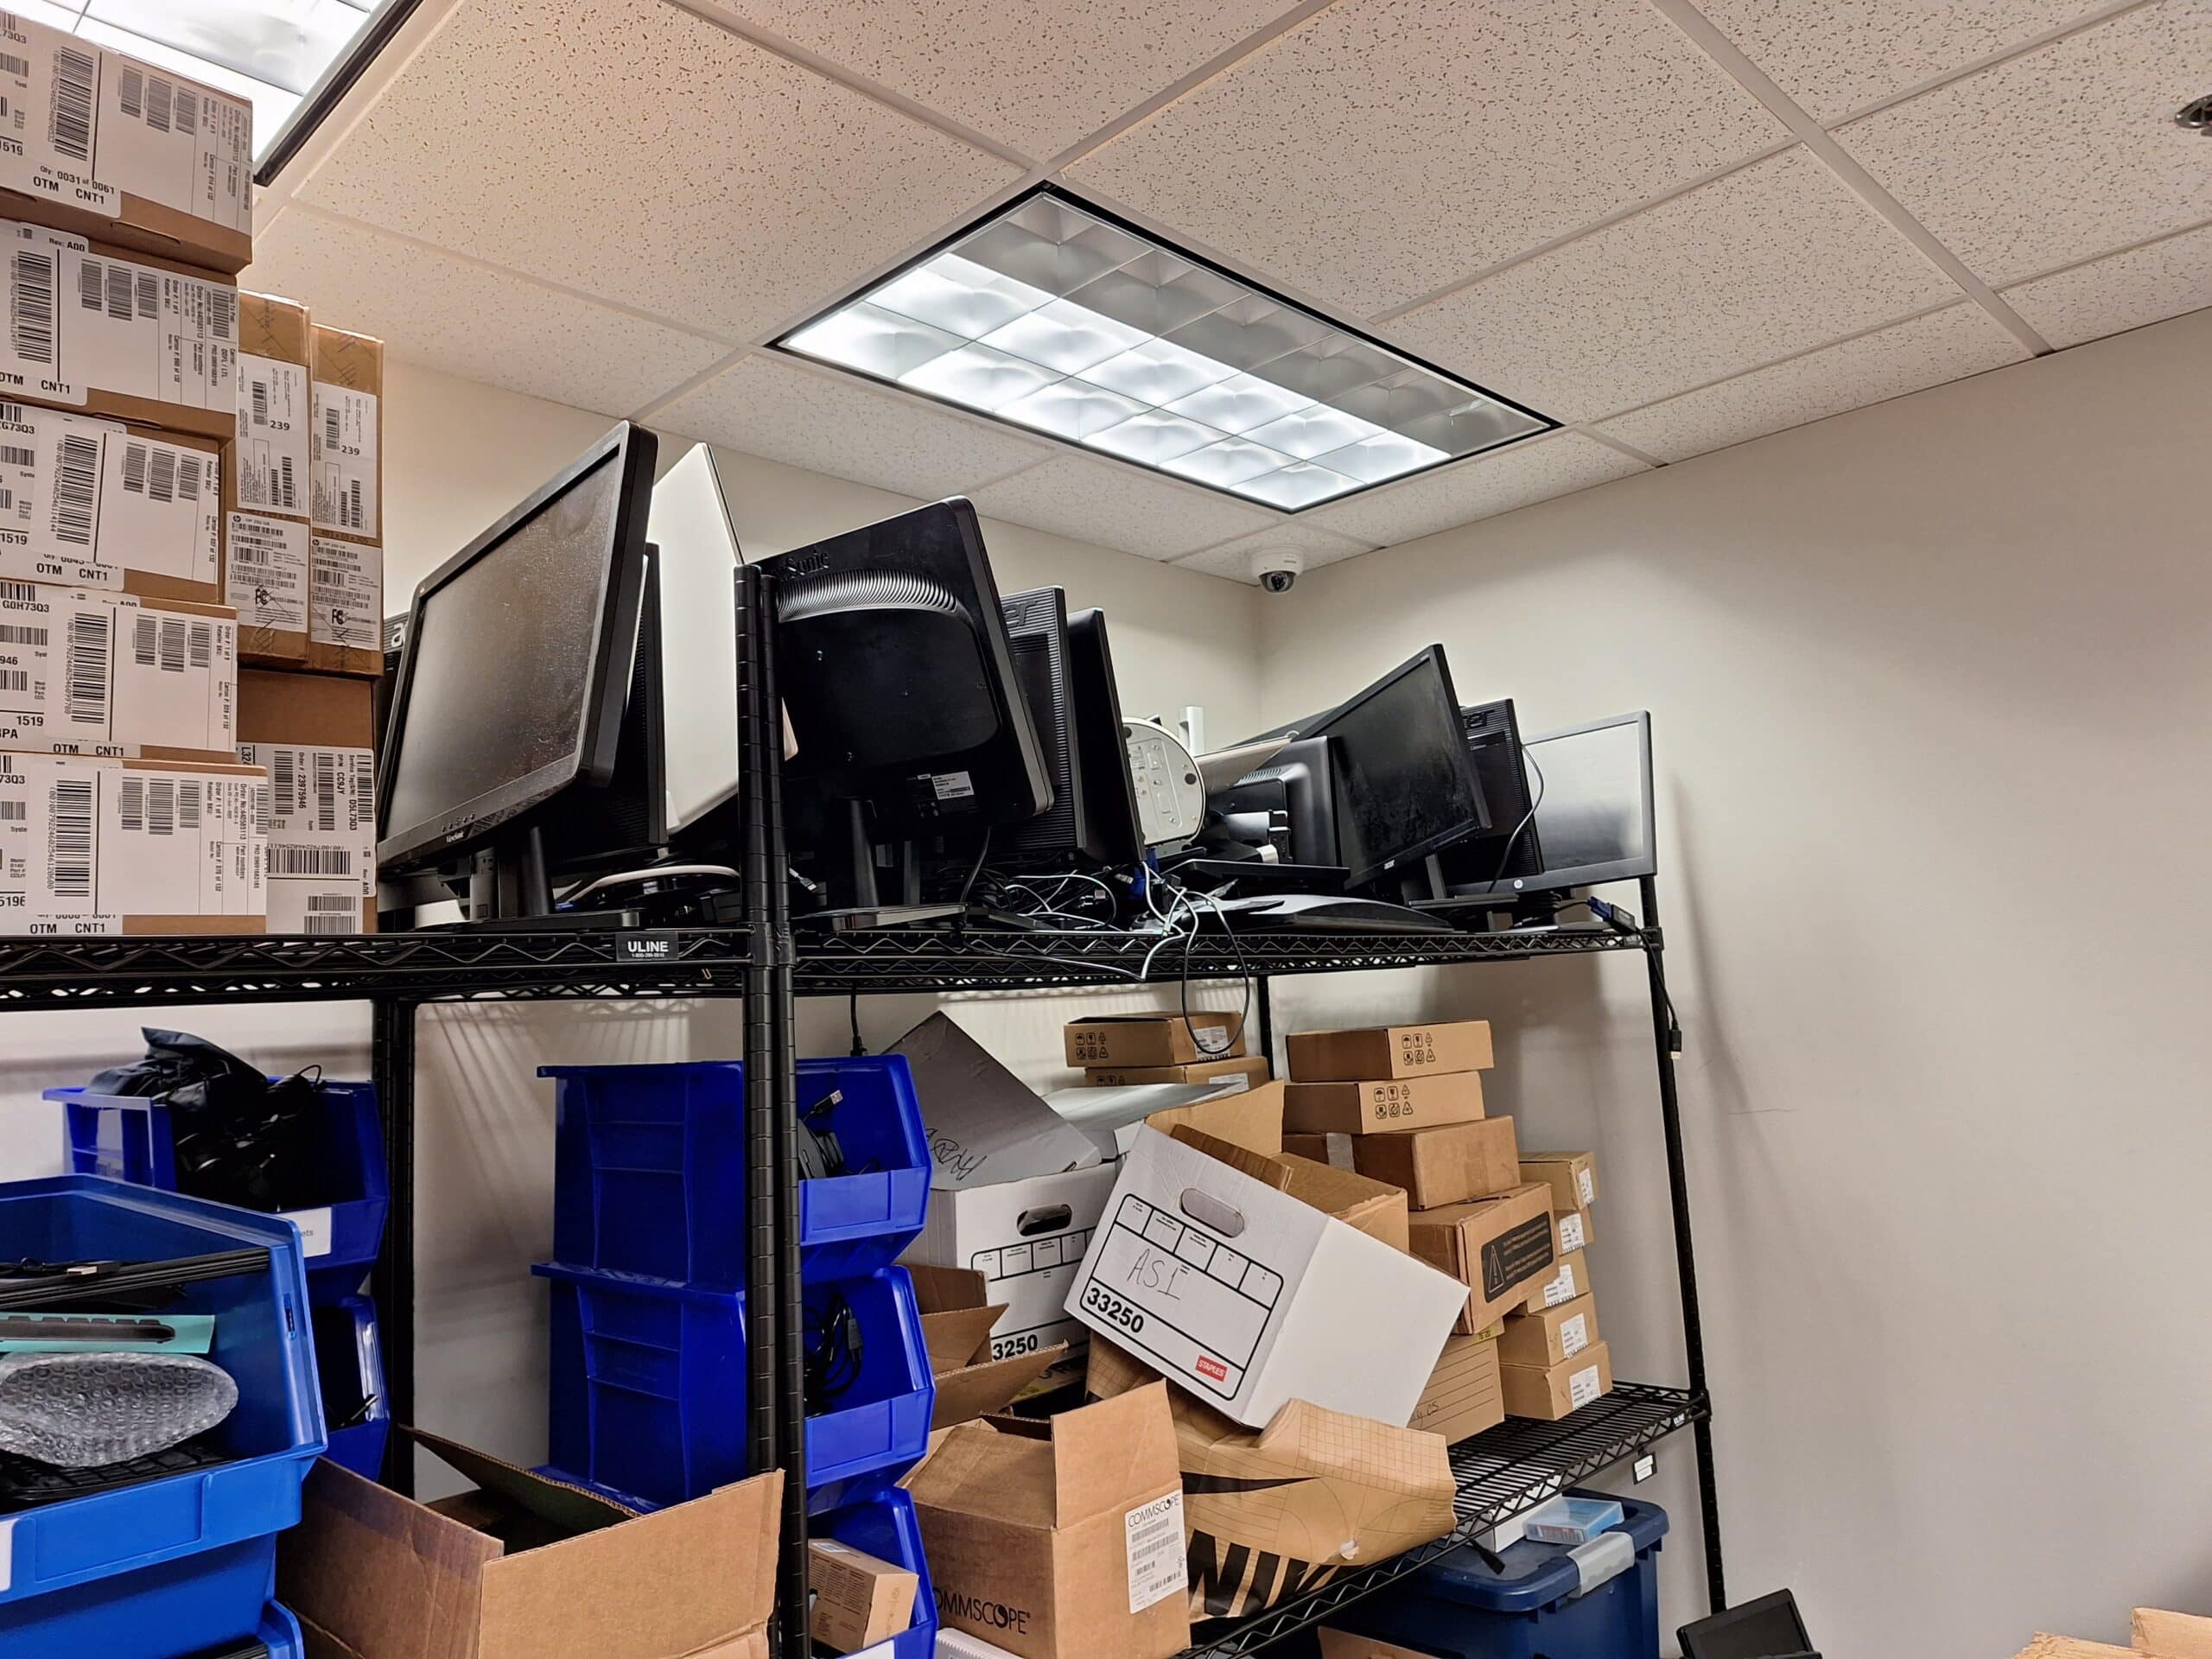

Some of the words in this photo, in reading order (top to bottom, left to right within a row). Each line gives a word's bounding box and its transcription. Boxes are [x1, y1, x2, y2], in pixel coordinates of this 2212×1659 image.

[0, 28, 27, 45] 73Q3
[57, 171, 80, 185] 0031
[33, 176, 60, 192] OTM
[75, 188, 105, 205] CNT1
[67, 241, 86, 253] A00
[0, 371, 24, 386] OTM
[41, 380, 71, 395] CNT1
[0, 421, 35, 435] G73Q3
[270, 420, 290, 431] 239
[341, 445, 360, 456] 239
[1, 532, 28, 545] 1519
[36, 563, 63, 575] OTM
[79, 569, 108, 582] CNT1
[16, 715, 44, 727] 1519
[53, 743, 79, 754] OTM
[95, 746, 124, 757] CNT1
[337, 772, 346, 795] CC9JY
[298, 774, 307, 810] 23975946
[29, 923, 57, 935] OTM
[74, 923, 105, 934] CNT1
[627, 940, 669, 953] ULINE
[1087, 1287, 1145, 1334] 33250
[992, 1334, 1038, 1361] 3250
[1198, 1358, 1226, 1376] STAPLES
